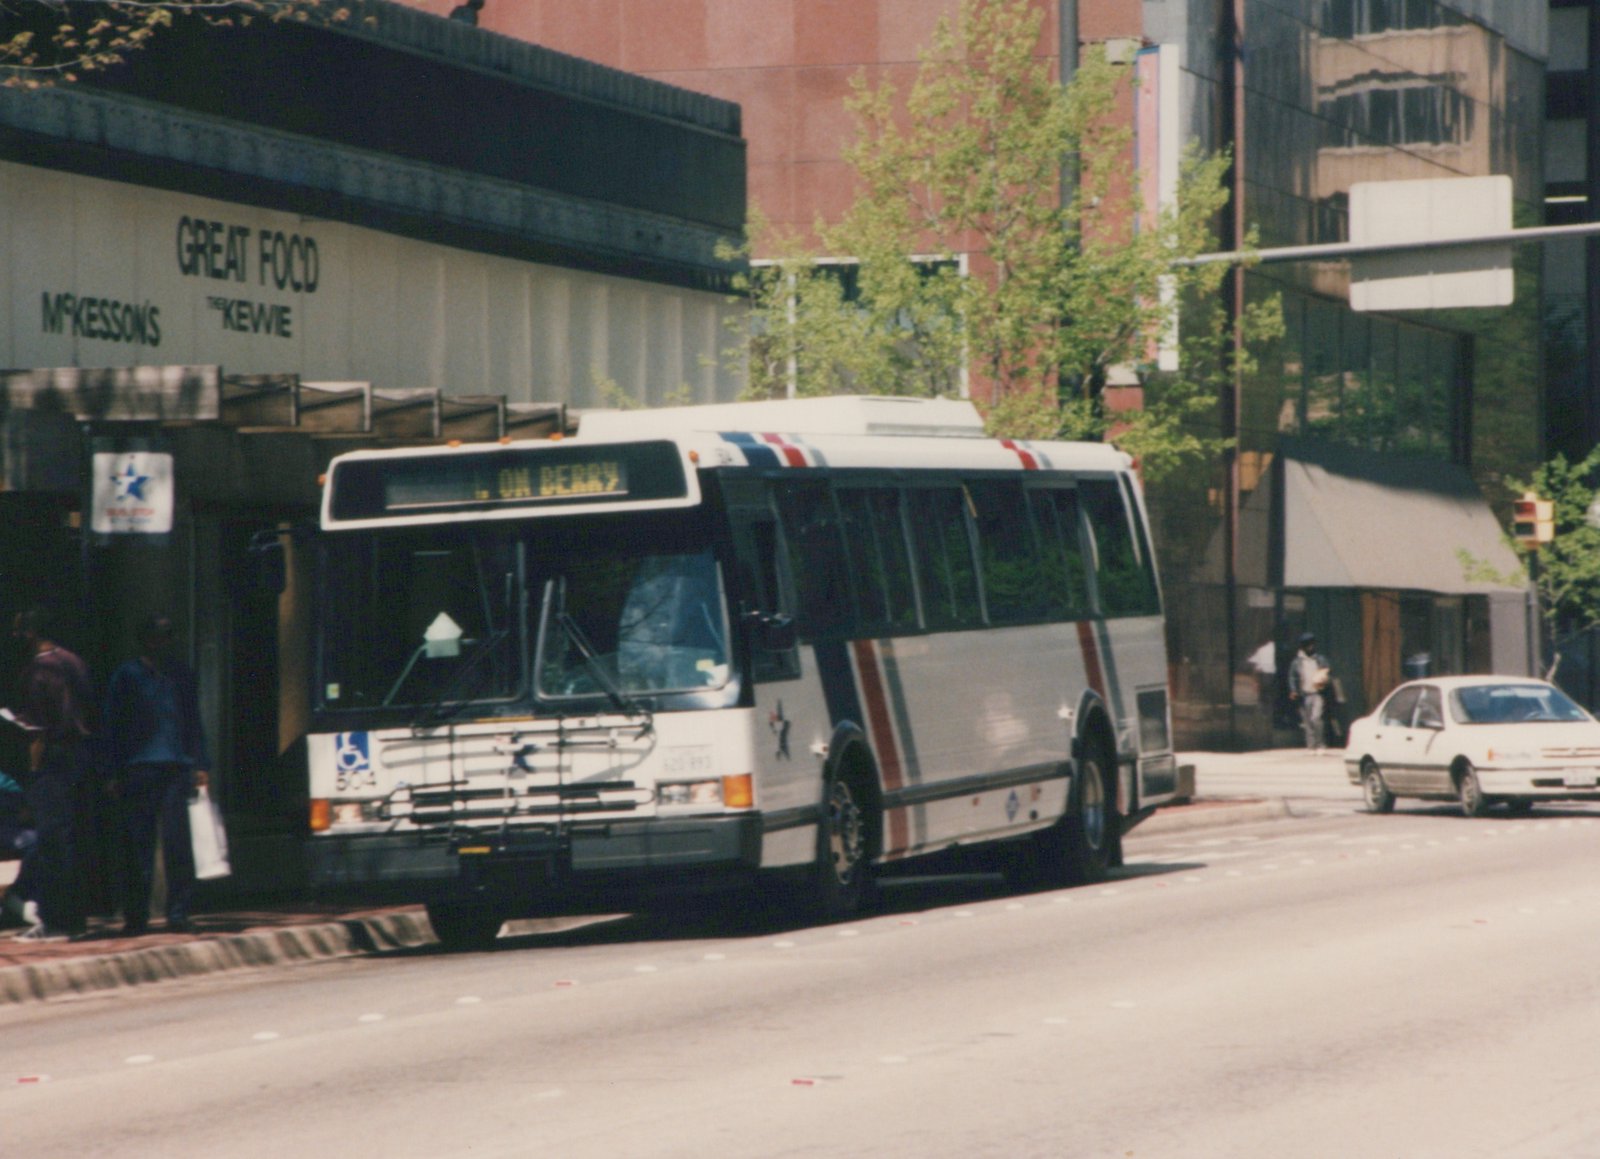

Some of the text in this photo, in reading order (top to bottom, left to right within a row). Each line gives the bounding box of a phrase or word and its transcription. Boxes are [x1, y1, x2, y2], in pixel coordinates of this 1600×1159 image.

[177, 215, 320, 293] GREAT FOOD
[539, 461, 620, 496] BERRY
